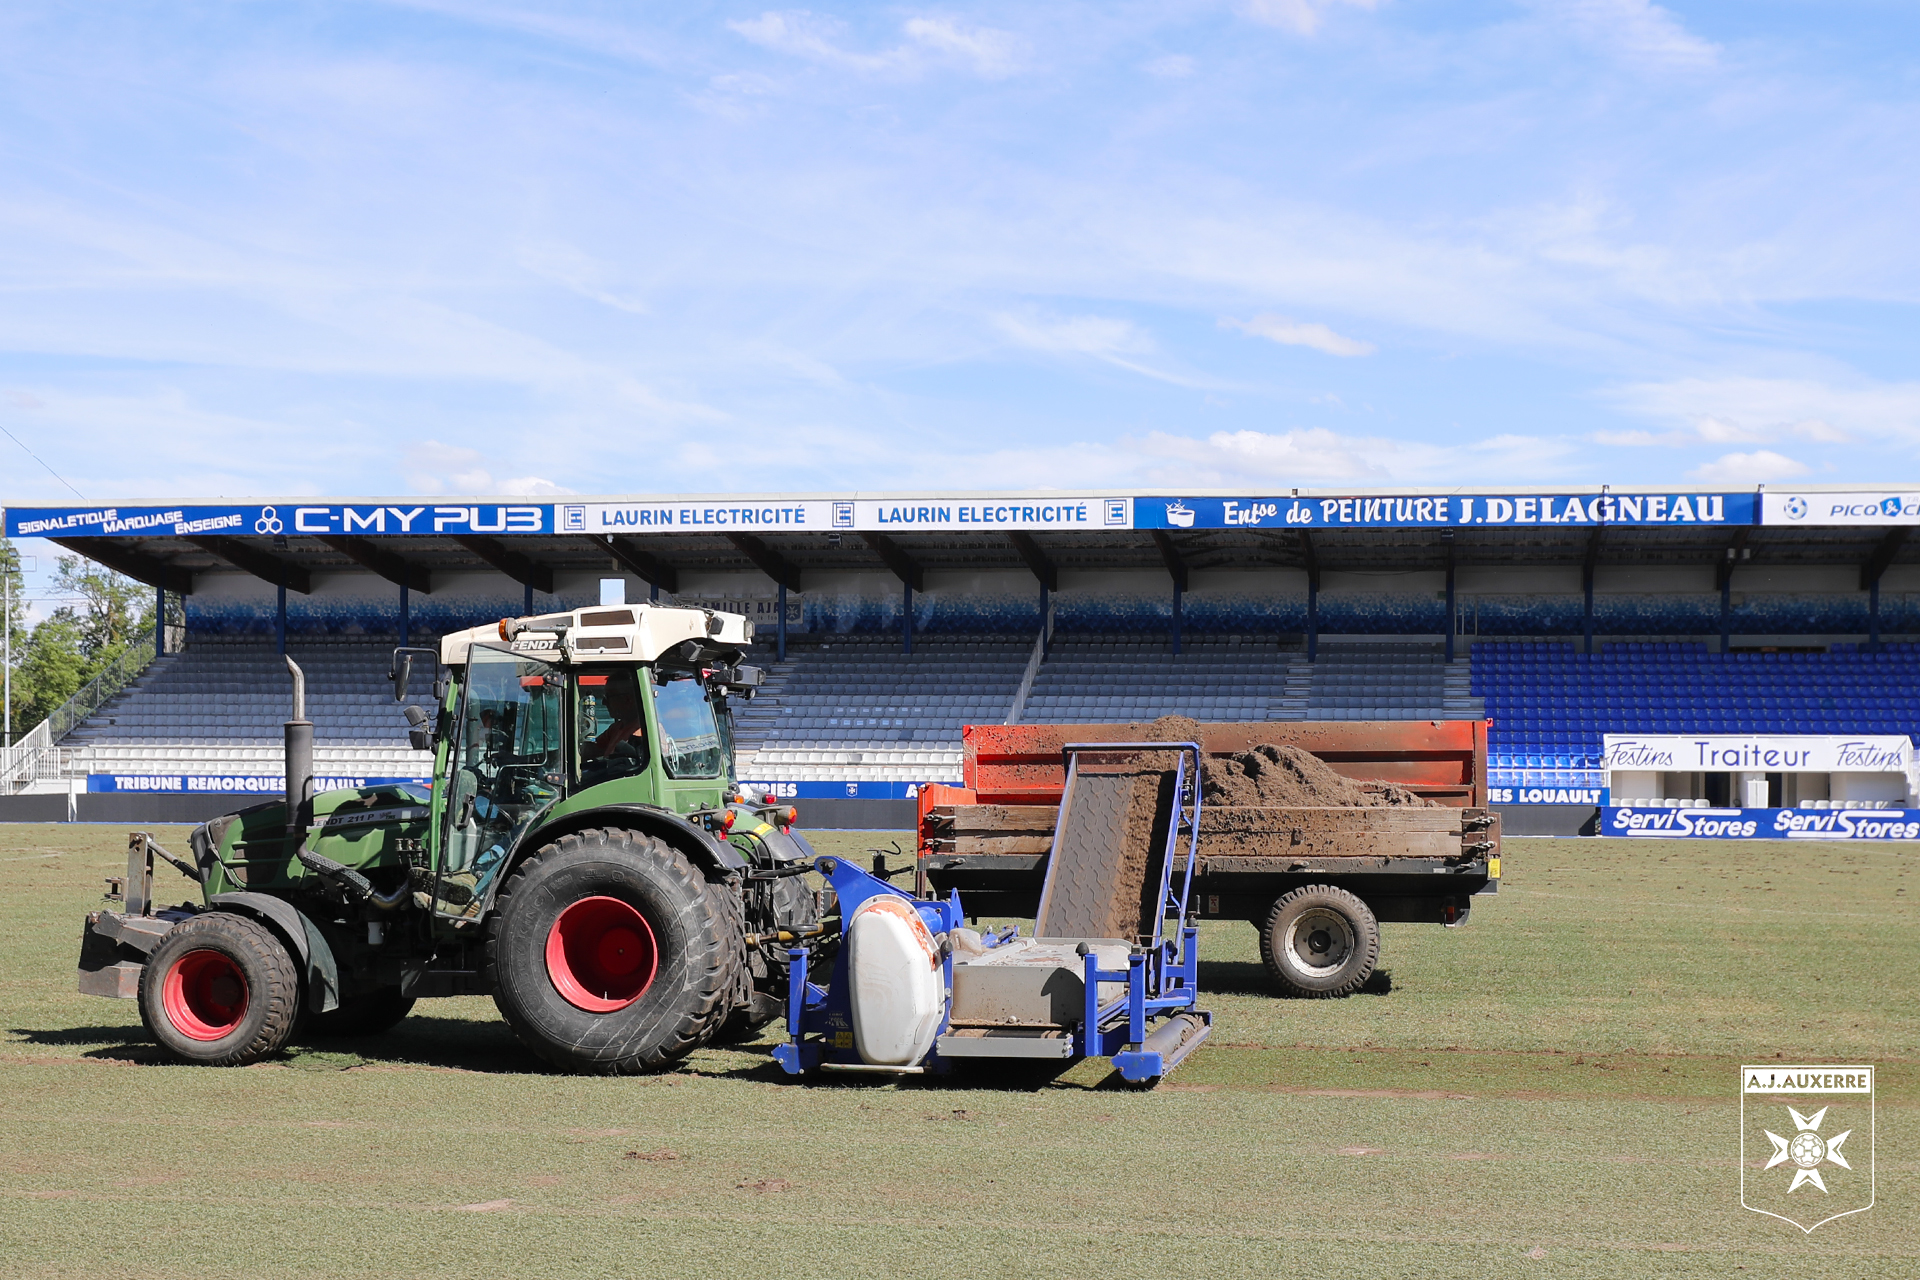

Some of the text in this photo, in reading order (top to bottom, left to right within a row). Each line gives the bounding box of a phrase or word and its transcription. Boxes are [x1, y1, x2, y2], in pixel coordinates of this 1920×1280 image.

[17, 508, 118, 535] SIGNALETIQUE
[601, 504, 805, 526] LAURIN ELECTRICITÉ
[878, 501, 1087, 523] LAURIN ELECTRICITÉ
[1285, 500, 1313, 524] de
[1319, 497, 1449, 522] PEINTURE
[102, 510, 183, 534] MARQUAGE
[174, 514, 242, 535] ENSEIGNE
[510, 640, 557, 651] FENDT
[1608, 741, 1903, 767] Festins Traiteur Festins
[115, 776, 182, 791] TRIBUNE
[187, 777, 286, 792] REMORQUES
[1519, 788, 1601, 804] LOUAULT
[347, 815, 364, 823] 211
[367, 813, 375, 821] P
[1613, 808, 1757, 837] ServiStores
[1773, 809, 1919, 839] ServiStores
